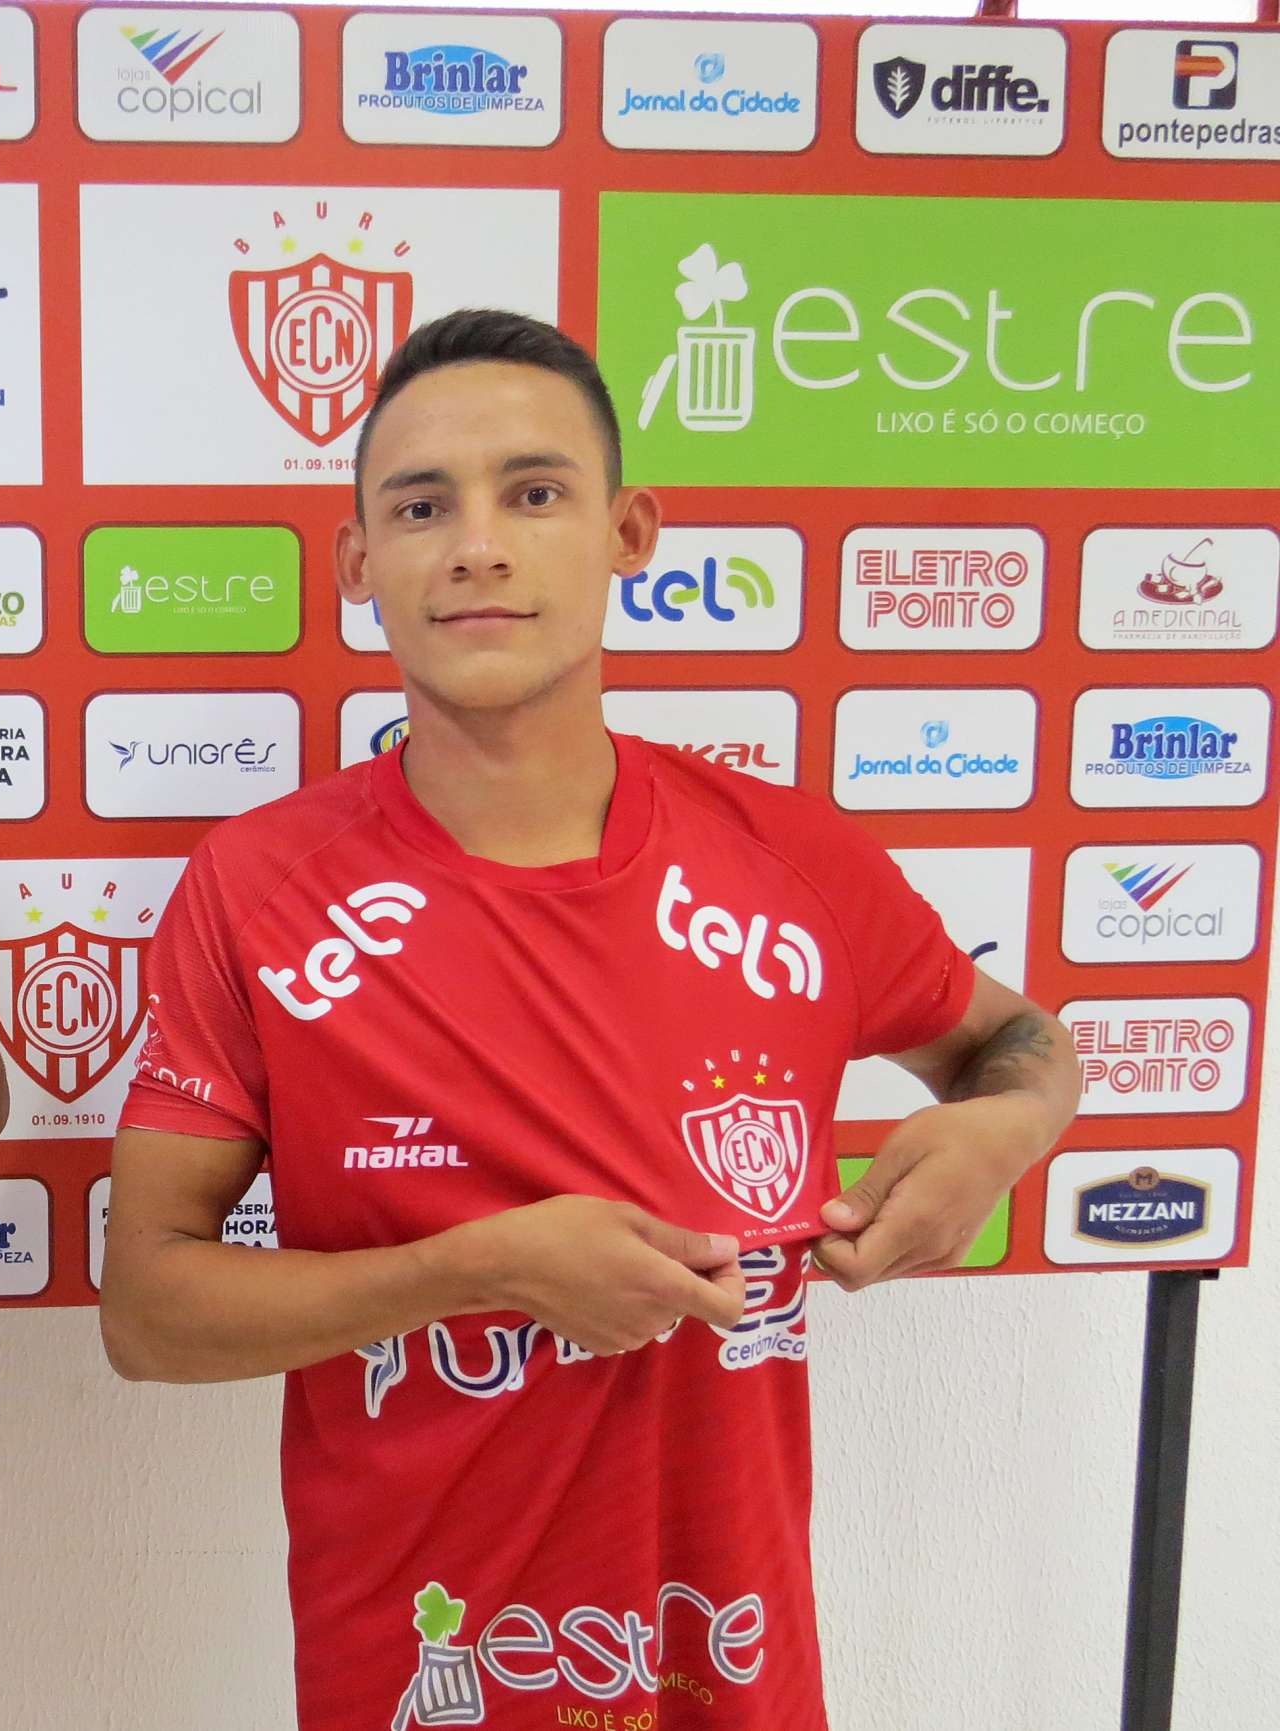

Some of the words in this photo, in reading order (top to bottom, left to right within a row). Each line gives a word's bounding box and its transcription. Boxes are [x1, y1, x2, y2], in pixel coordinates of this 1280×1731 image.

[384, 51, 528, 94] Brinlar
[117, 80, 262, 121] copical
[358, 94, 446, 109] PRODUTOS
[451, 96, 472, 109] DE
[477, 96, 545, 111] LIMPEZA
[618, 87, 686, 116] Jornal
[689, 89, 718, 112] da
[722, 89, 801, 116] Cidade
[288, 305, 355, 375] ECN
[772, 286, 1253, 393] estre
[876, 411, 934, 434] LIXO
[942, 408, 956, 434] É
[963, 408, 1000, 434] SÓ
[1006, 411, 1027, 434] O
[1033, 412, 1146, 440] COMEÇO
[854, 548, 1029, 588] ELETRO
[145, 574, 275, 603] estre
[1132, 609, 1243, 628] MEDICINAL
[1110, 723, 1239, 760] Brinlar
[847, 753, 913, 781] Jornal
[915, 753, 943, 775] da
[945, 752, 1020, 779] Cidade
[1085, 762, 1163, 776] PRODUTOS
[1168, 762, 1187, 775] DE
[1191, 761, 1253, 775] LIMPEZA
[1095, 906, 1224, 945] copical
[34, 970, 101, 1037] ECN
[1070, 1017, 1236, 1055] ELETRO
[31, 1112, 106, 1127] 01.09.1910
[730, 1129, 777, 1175] ECN
[1087, 1200, 1196, 1223] MEZZANI
[478, 1582, 764, 1700] estre
[556, 1704, 599, 1729] LIXO
